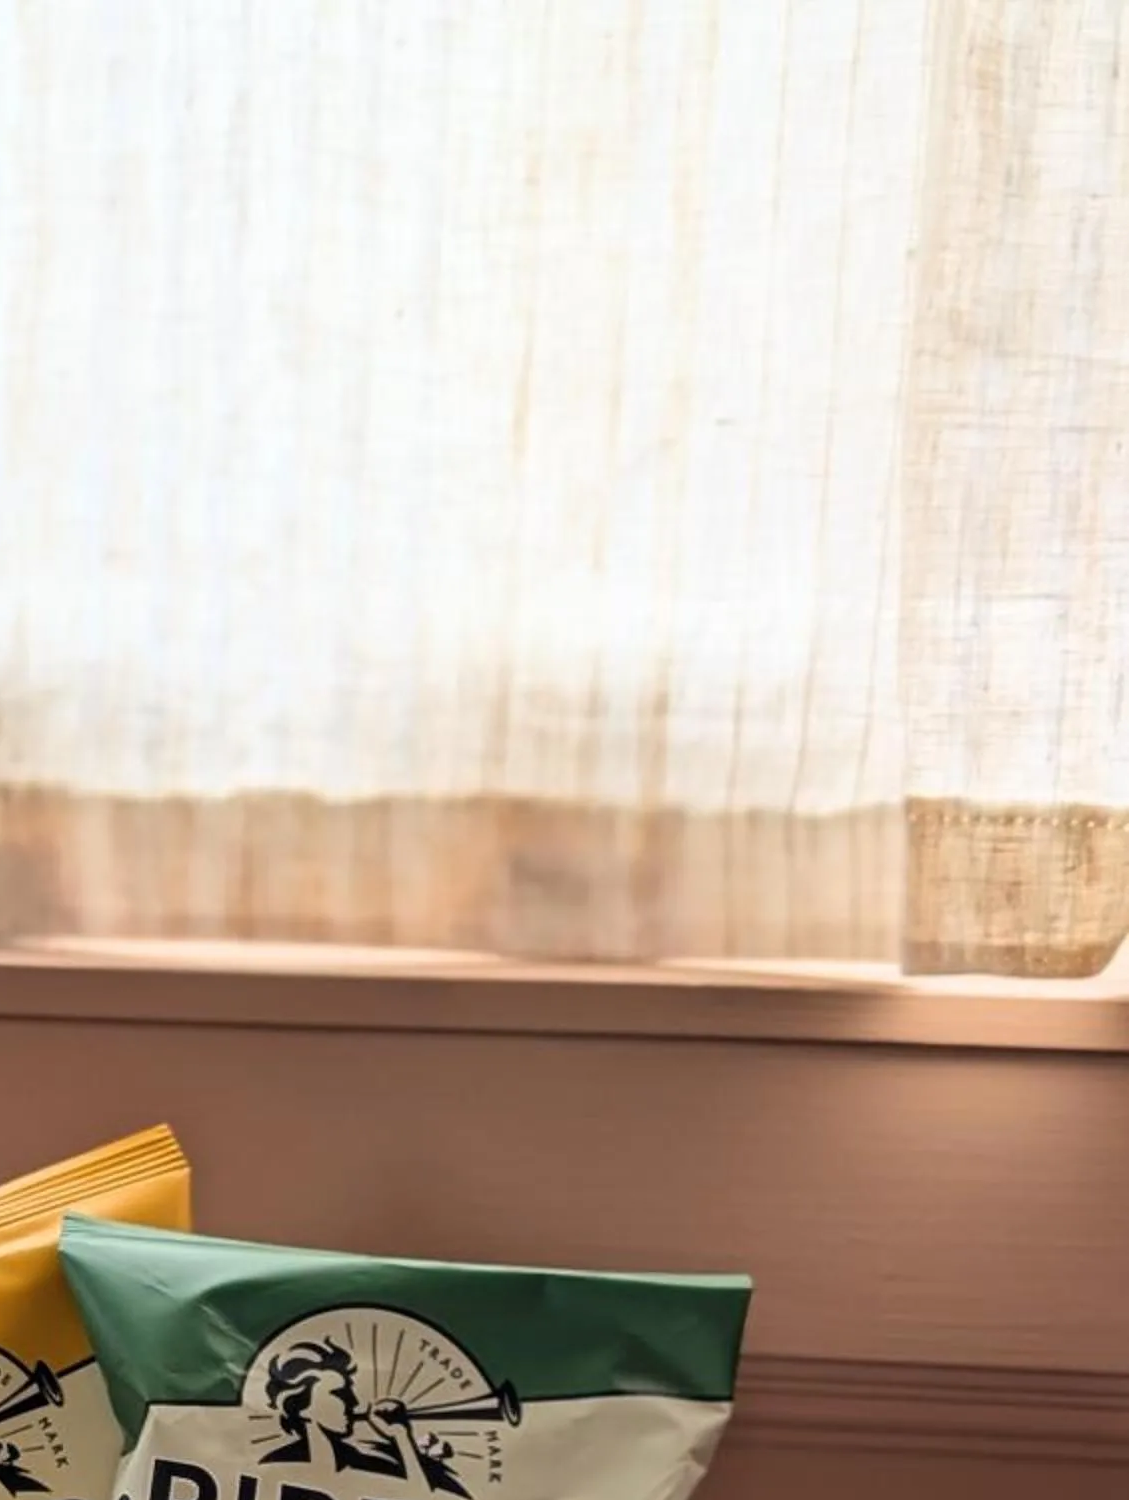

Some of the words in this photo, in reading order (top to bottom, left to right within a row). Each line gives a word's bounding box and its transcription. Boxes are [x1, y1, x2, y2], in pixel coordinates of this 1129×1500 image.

[418, 1338, 473, 1391] TRADE
[38, 1416, 70, 1469] MARK
[485, 1430, 503, 1484] MARK
